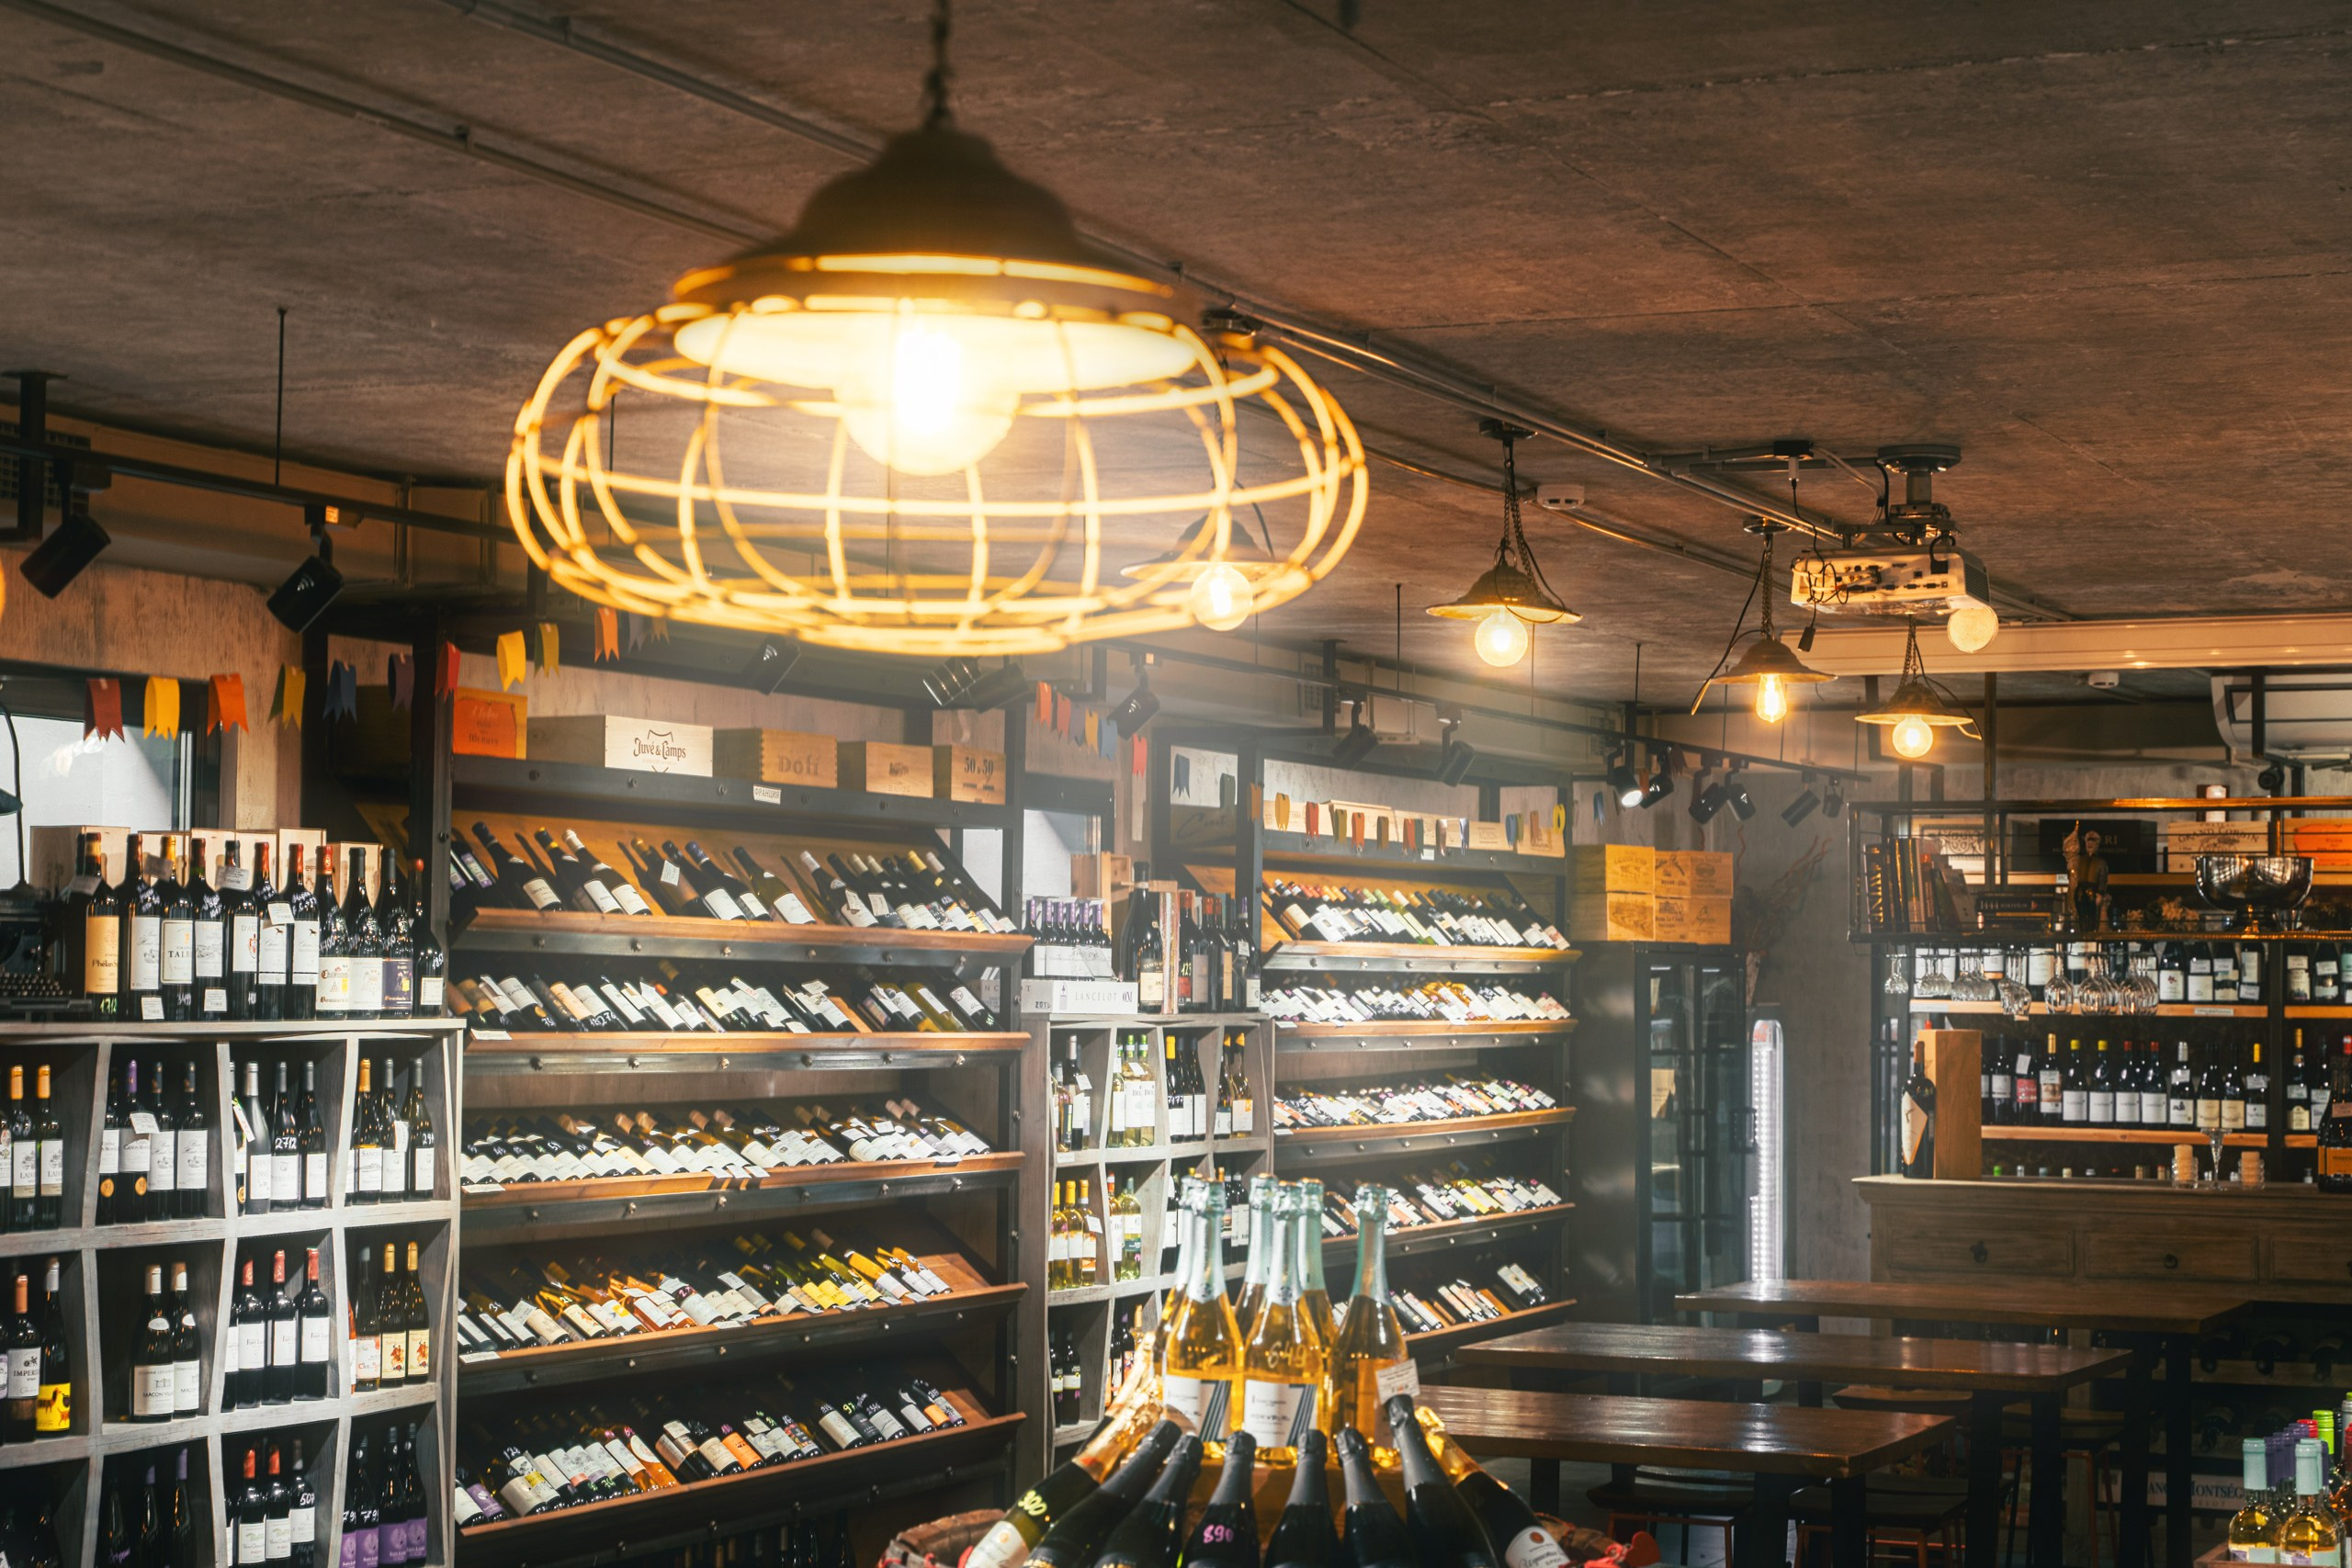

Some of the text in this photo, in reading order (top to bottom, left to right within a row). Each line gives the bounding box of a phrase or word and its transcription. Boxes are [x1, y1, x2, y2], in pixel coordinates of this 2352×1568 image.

[633, 737, 686, 761] Juvé & Camps
[964, 757, 976, 773] 50
[982, 759, 994, 775] 50
[754, 787, 780, 799] ФРАНЦИЯ
[2177, 826, 2260, 843] GRAND CORBIN
[1075, 991, 1117, 1002] LANCELOT
[1267, 1341, 1307, 1369] 649
[1203, 1524, 1234, 1543] 890
